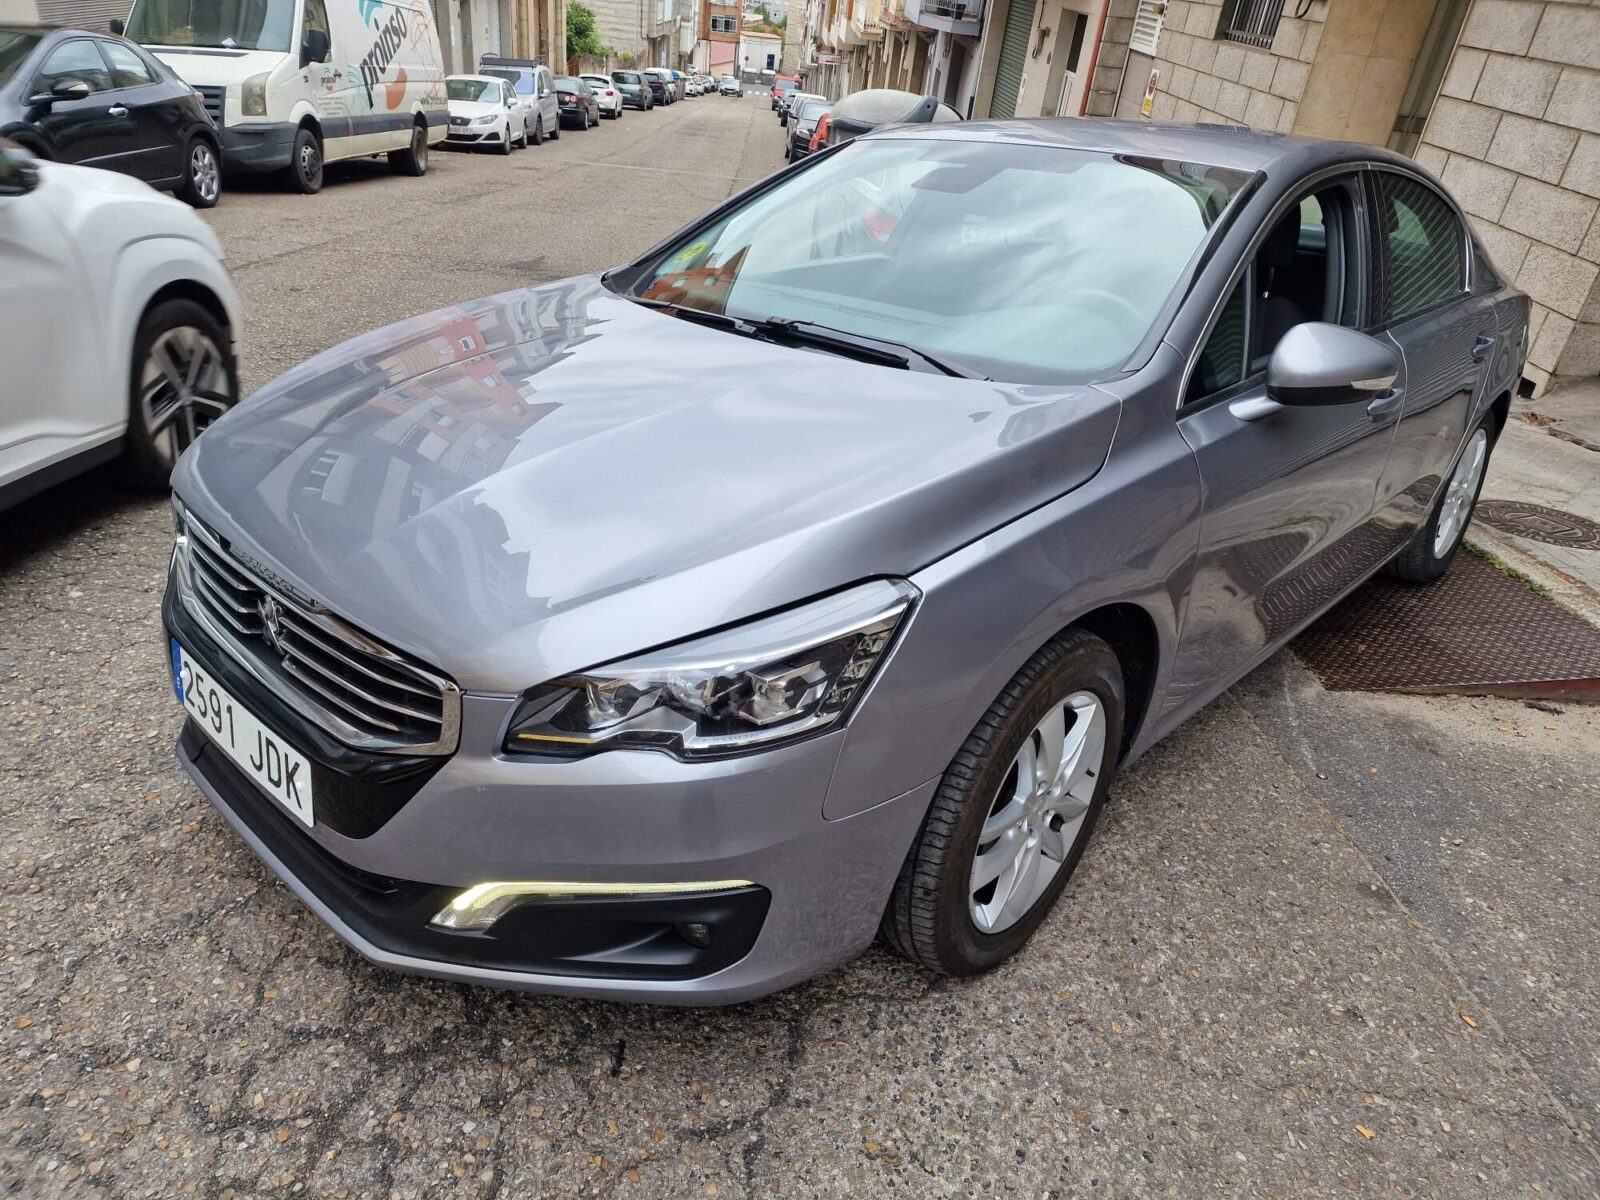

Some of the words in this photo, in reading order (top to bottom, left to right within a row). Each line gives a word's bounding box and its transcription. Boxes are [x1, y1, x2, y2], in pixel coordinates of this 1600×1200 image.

[360, 6, 407, 110] proinso
[183, 660, 235, 749] 2591
[250, 729, 303, 810] JDK
